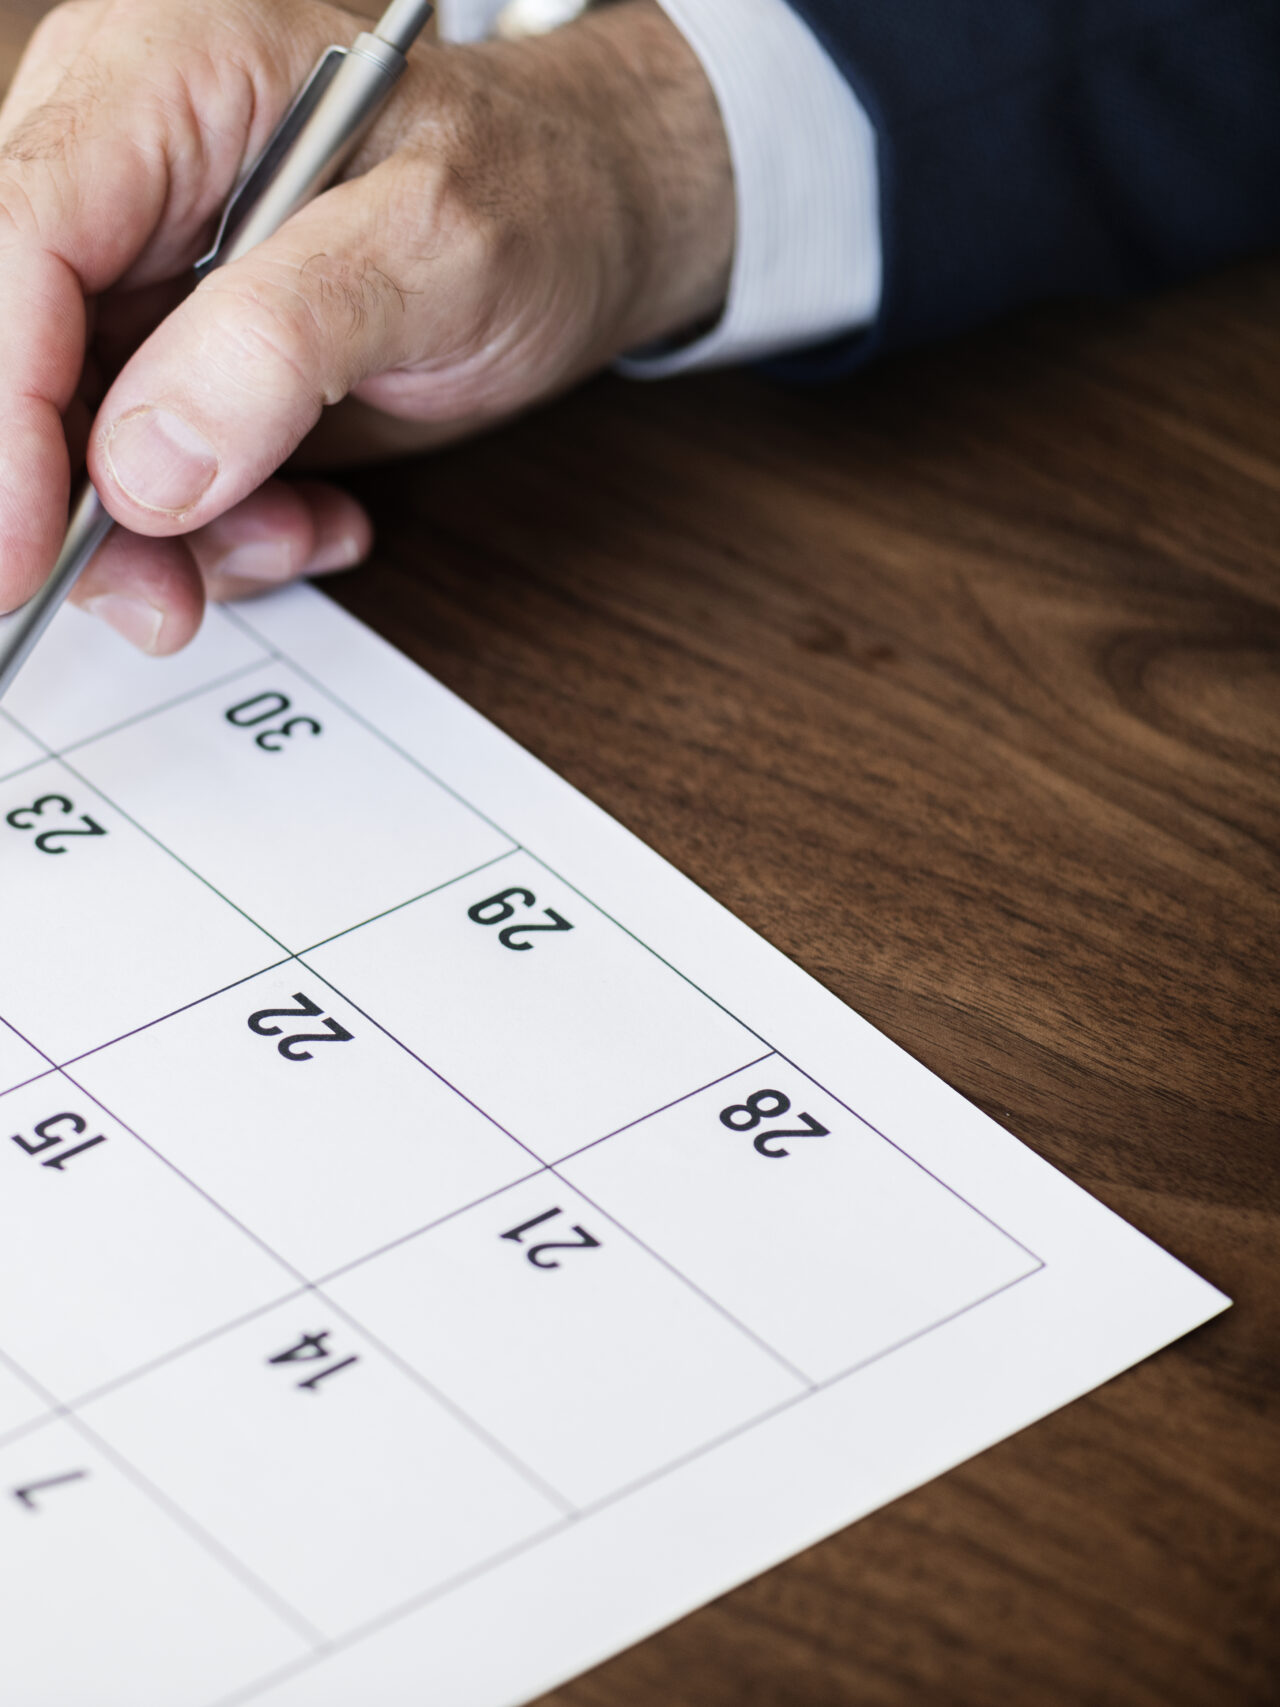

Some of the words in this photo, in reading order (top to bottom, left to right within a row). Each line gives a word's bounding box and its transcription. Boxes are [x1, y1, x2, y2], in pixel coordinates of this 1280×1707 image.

[225, 692, 322, 752] 30
[6, 794, 107, 854] 23
[467, 887, 574, 951] 29
[248, 992, 355, 1061] 22
[11, 1112, 107, 1171] 15
[719, 1089, 831, 1158] 28
[500, 1207, 601, 1269] 21
[268, 1331, 358, 1390] 14
[11, 1468, 88, 1512] 7
